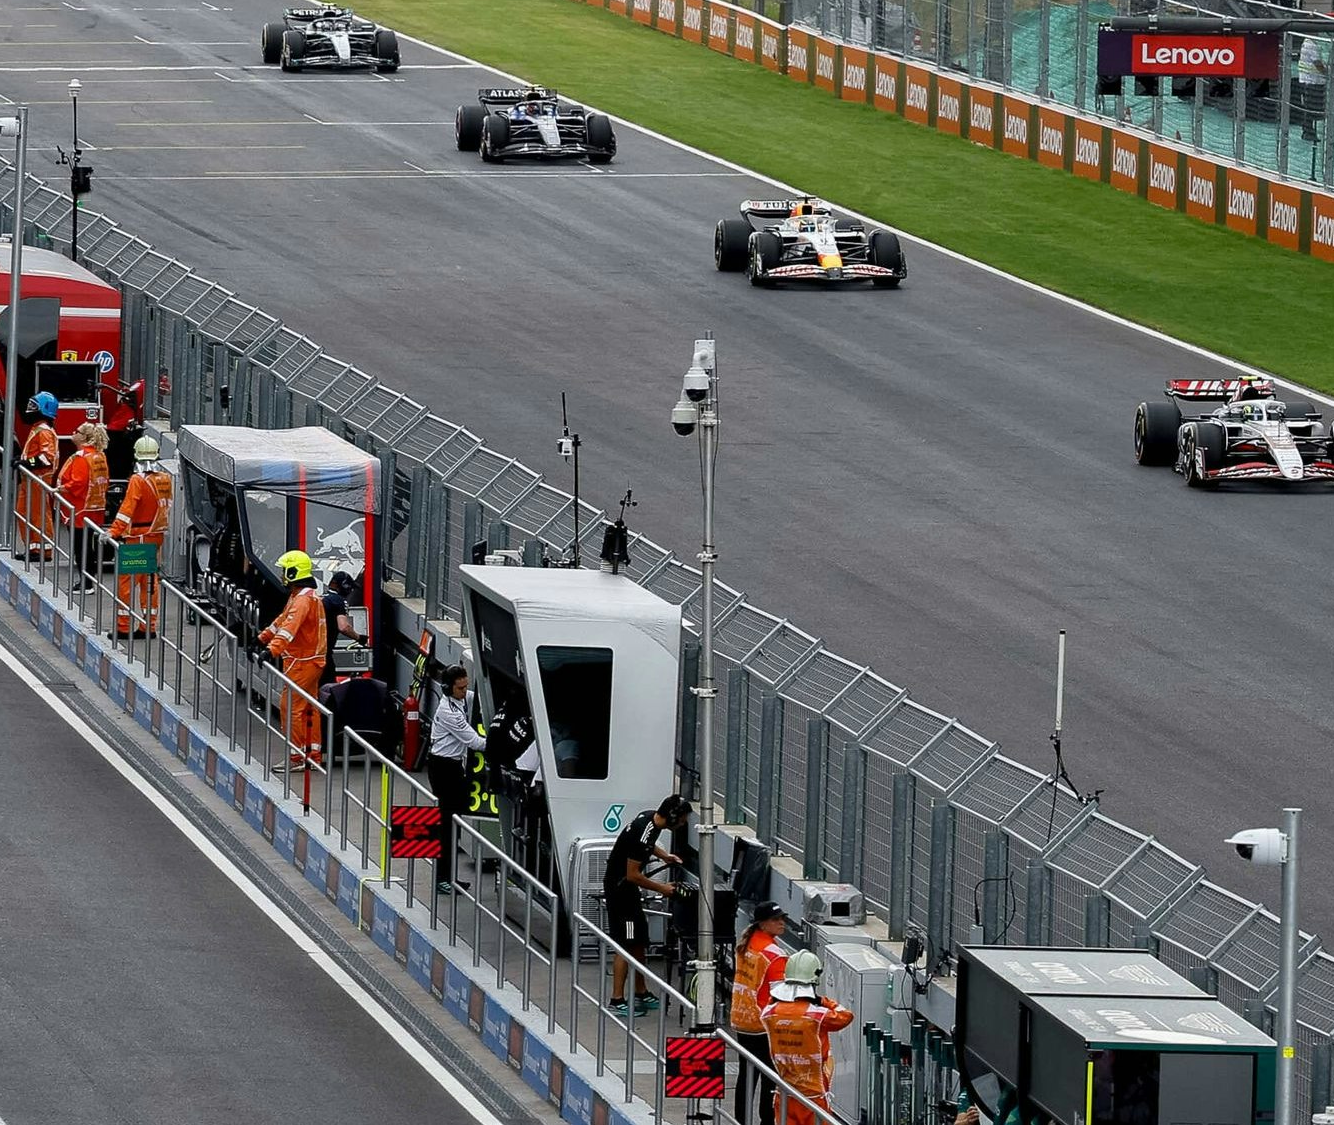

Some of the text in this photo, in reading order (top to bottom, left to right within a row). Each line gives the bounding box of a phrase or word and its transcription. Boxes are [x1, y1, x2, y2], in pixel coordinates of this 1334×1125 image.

[816, 46, 835, 81] Lenovo
[1141, 43, 1234, 66] Lenovo
[843, 57, 867, 90] Lenovo
[875, 65, 895, 100] Lenovo
[906, 76, 927, 111] Lenovo
[938, 87, 960, 121] Lenovo
[970, 96, 993, 131] Lenovo
[1004, 107, 1027, 143] Lenovo
[1040, 118, 1064, 155] Lenovo
[1075, 130, 1099, 166] Lenovo
[1113, 139, 1138, 178] Lenovo
[1150, 154, 1175, 193] Lenovo
[1188, 168, 1213, 207] Lenovo
[1227, 180, 1256, 219] Lenovo
[1270, 193, 1297, 233] Lenovo
